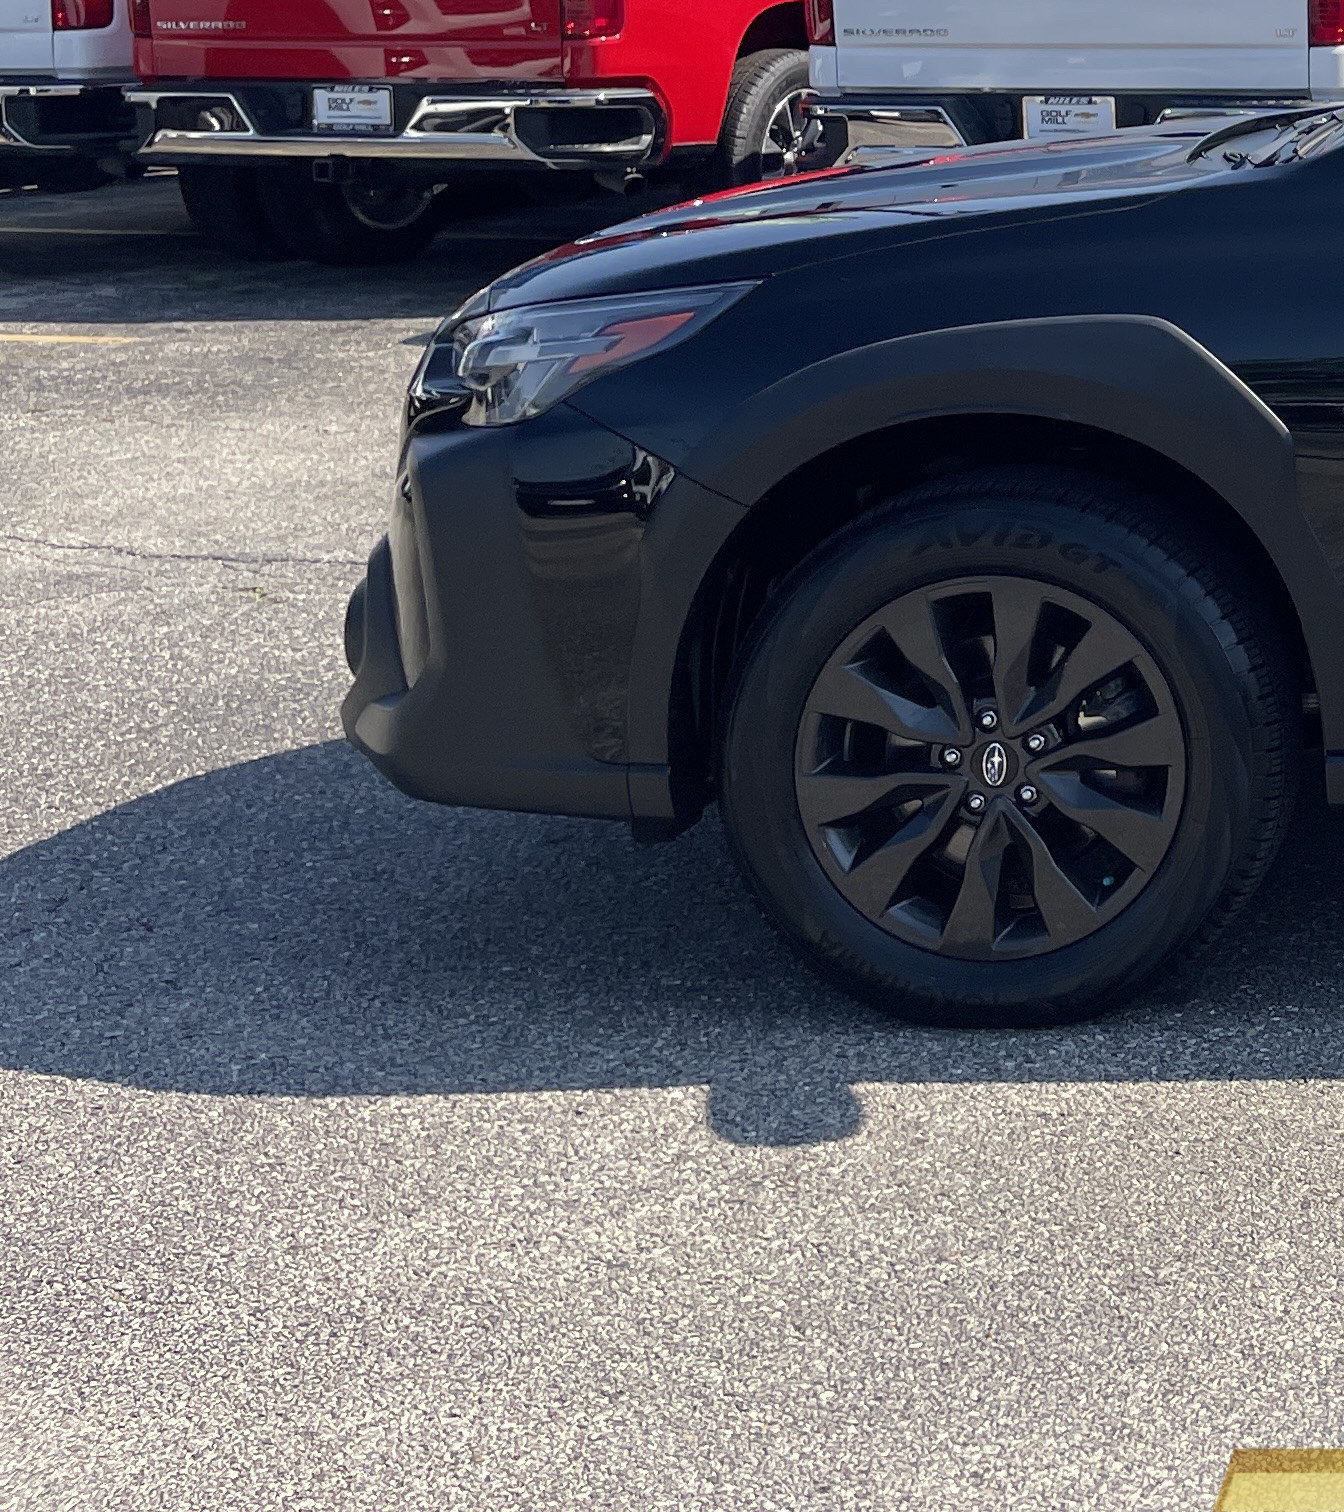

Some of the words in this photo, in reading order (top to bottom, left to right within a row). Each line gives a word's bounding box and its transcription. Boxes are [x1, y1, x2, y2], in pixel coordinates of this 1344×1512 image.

[156, 20, 247, 30] SILVERADO
[1040, 109, 1073, 118] GOLF
[1040, 117, 1068, 126] MILL
